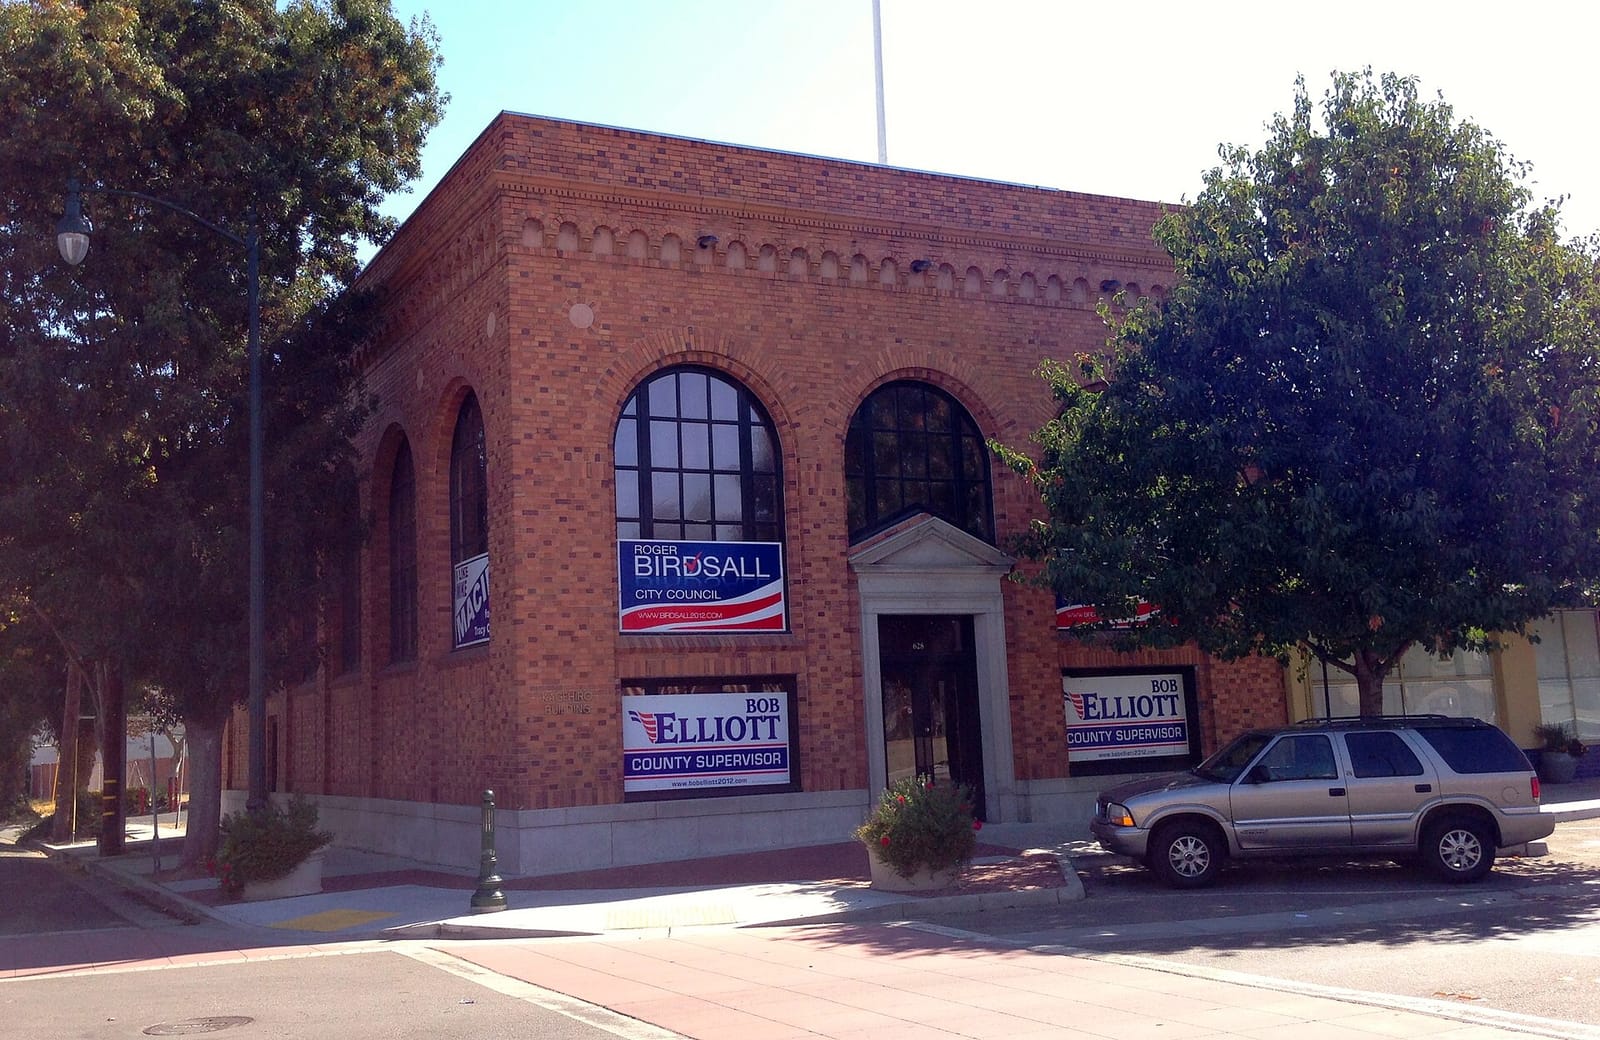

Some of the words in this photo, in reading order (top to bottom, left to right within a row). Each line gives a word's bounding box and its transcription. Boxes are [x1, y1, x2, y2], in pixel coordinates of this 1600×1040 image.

[634, 544, 678, 555] ROGER
[634, 555, 771, 578] BIRDSALL
[455, 564, 489, 643] MACI
[635, 589, 664, 600] CITY
[666, 589, 722, 600] COUNCIL
[1151, 679, 1178, 693] BOB
[745, 698, 780, 714] BOB
[1081, 692, 1180, 721] ELLIOTT
[653, 712, 781, 744] ELLIOTT
[1067, 731, 1113, 744] COUNTY
[1116, 727, 1182, 741] SUPERVISOR
[632, 755, 692, 771] COUNTY
[696, 752, 781, 768] SUPERVISOR
